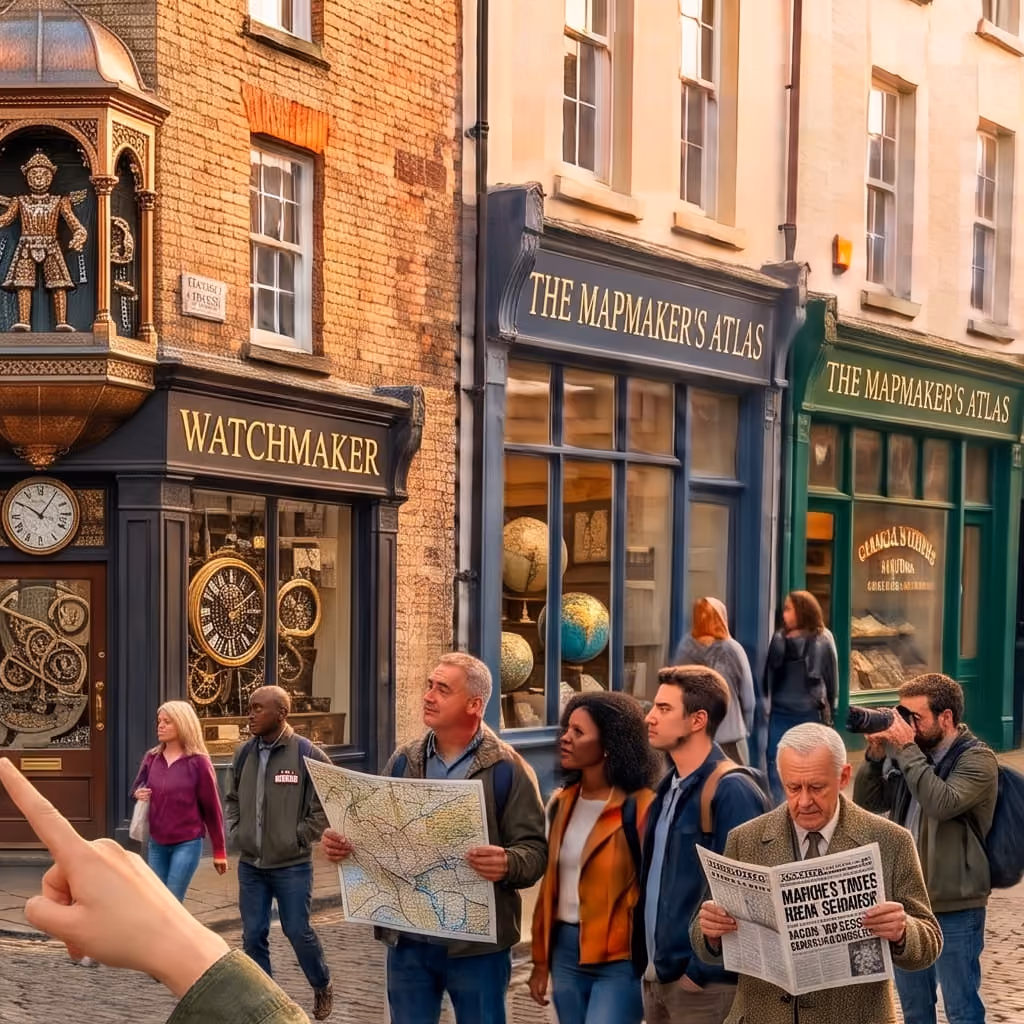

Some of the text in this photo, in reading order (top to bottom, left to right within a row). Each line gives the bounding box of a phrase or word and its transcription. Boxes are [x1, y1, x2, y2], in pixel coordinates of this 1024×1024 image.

[529, 271, 764, 360] THE MAPMAKER'S ATLAS
[827, 362, 1010, 424] THE MAPMAKER'S ATLAS
[179, 408, 380, 476] WATCHMAKER
